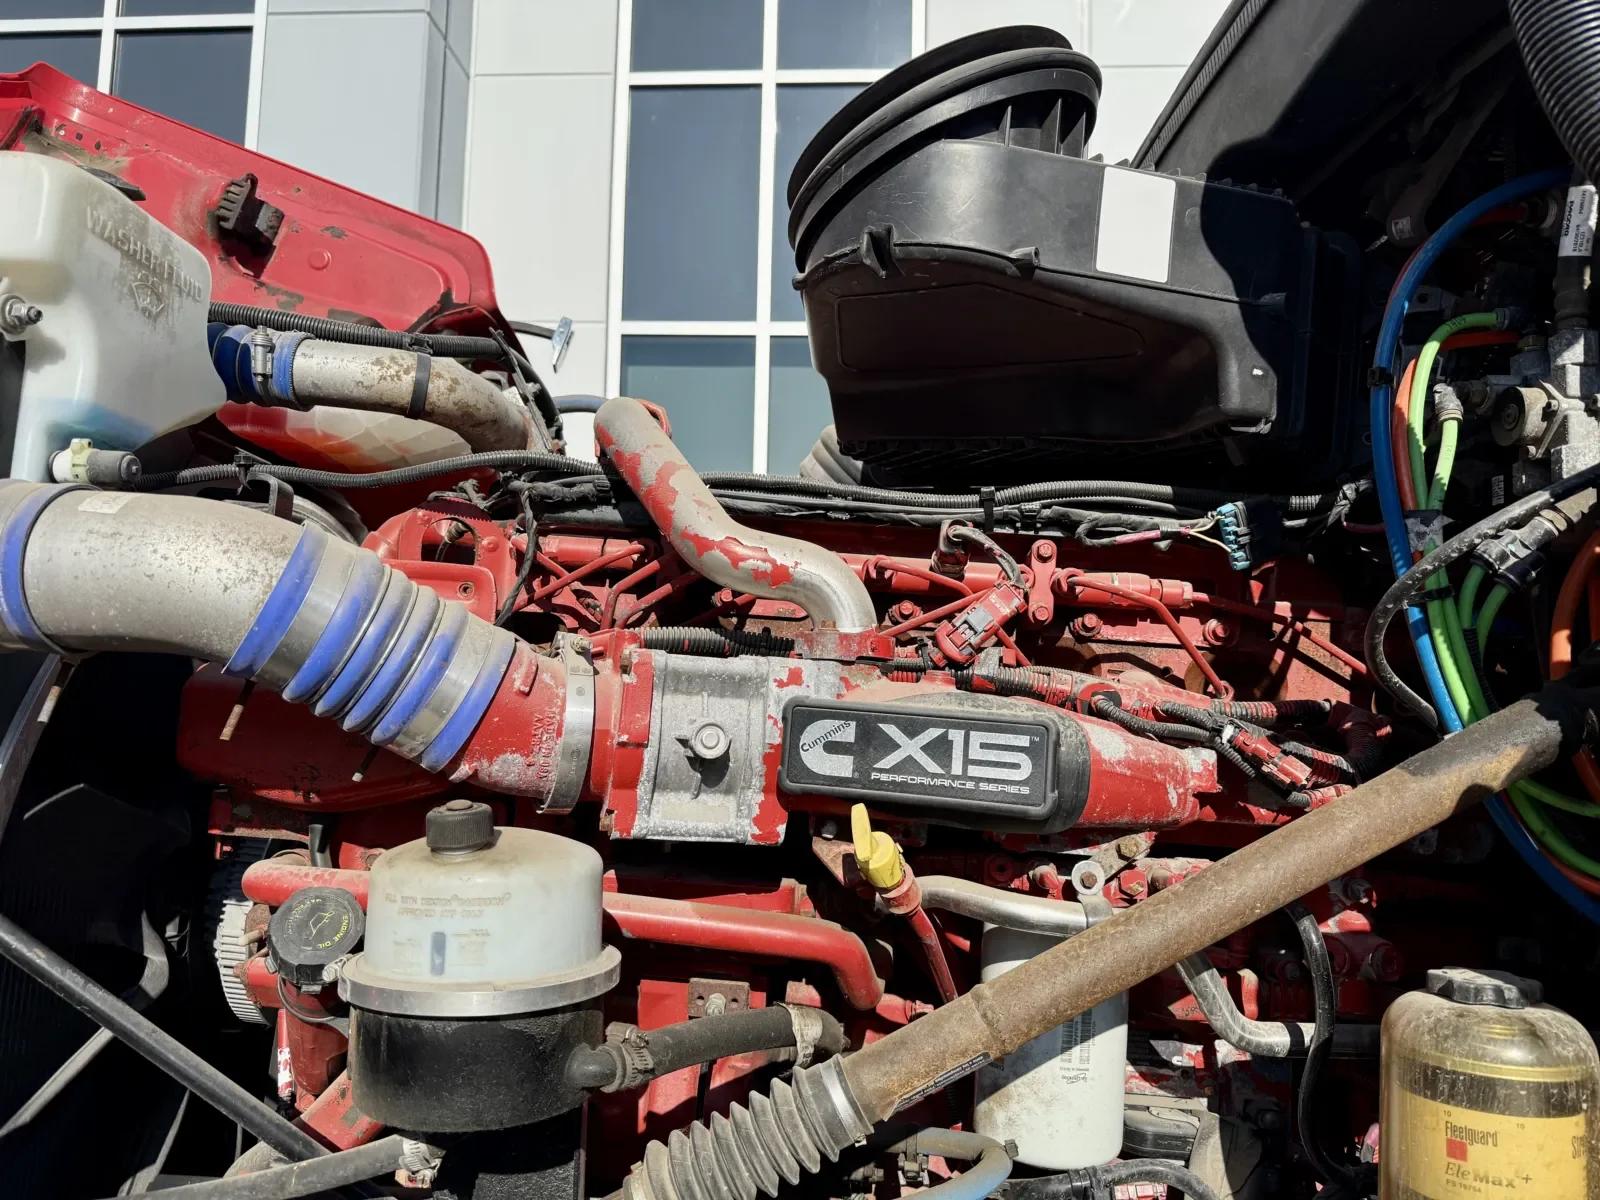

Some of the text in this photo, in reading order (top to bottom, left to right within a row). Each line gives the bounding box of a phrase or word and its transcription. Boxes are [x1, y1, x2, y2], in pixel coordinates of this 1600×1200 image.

[1564, 200, 1575, 237] PACCAR
[87, 206, 160, 272] WASHER
[801, 721, 851, 752] Cummins
[873, 723, 1033, 782] X15
[871, 772, 1030, 795] PERFORMANCE SERIES
[332, 914, 350, 942] ENGINE
[317, 940, 332, 949] OIL
[1445, 1120, 1499, 1148] Fleetguard
